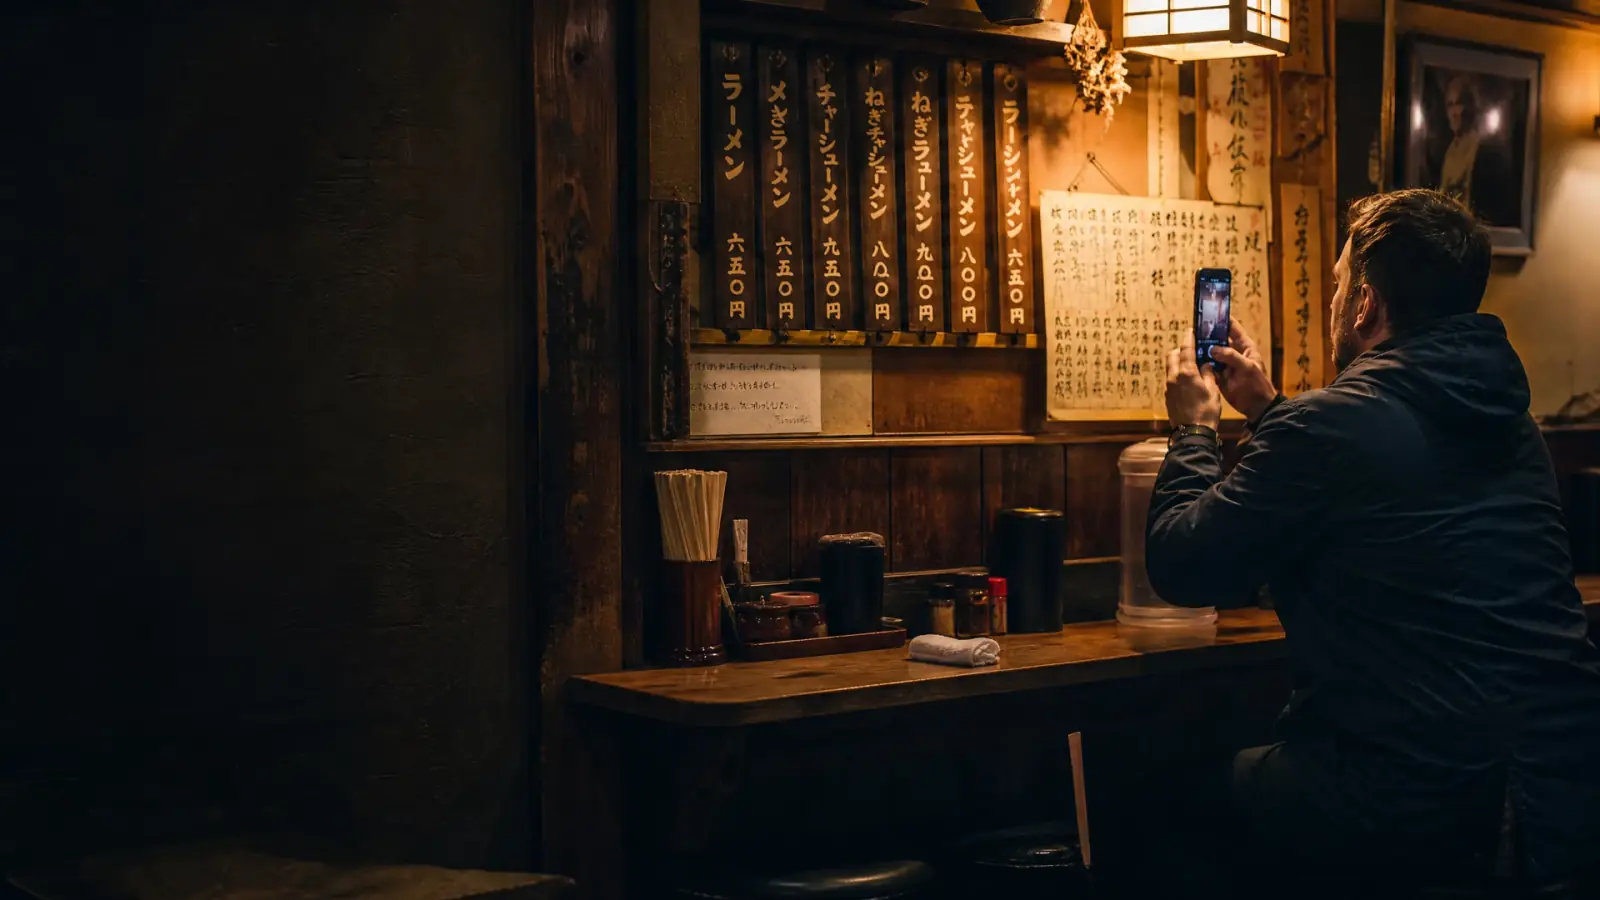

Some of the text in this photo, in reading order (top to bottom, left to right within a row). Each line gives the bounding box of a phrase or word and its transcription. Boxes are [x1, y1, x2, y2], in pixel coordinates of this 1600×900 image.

[722, 73, 745, 181] ラーメン
[816, 83, 840, 225] チャーシューメン
[865, 86, 888, 220] ねぎチャーシューメン
